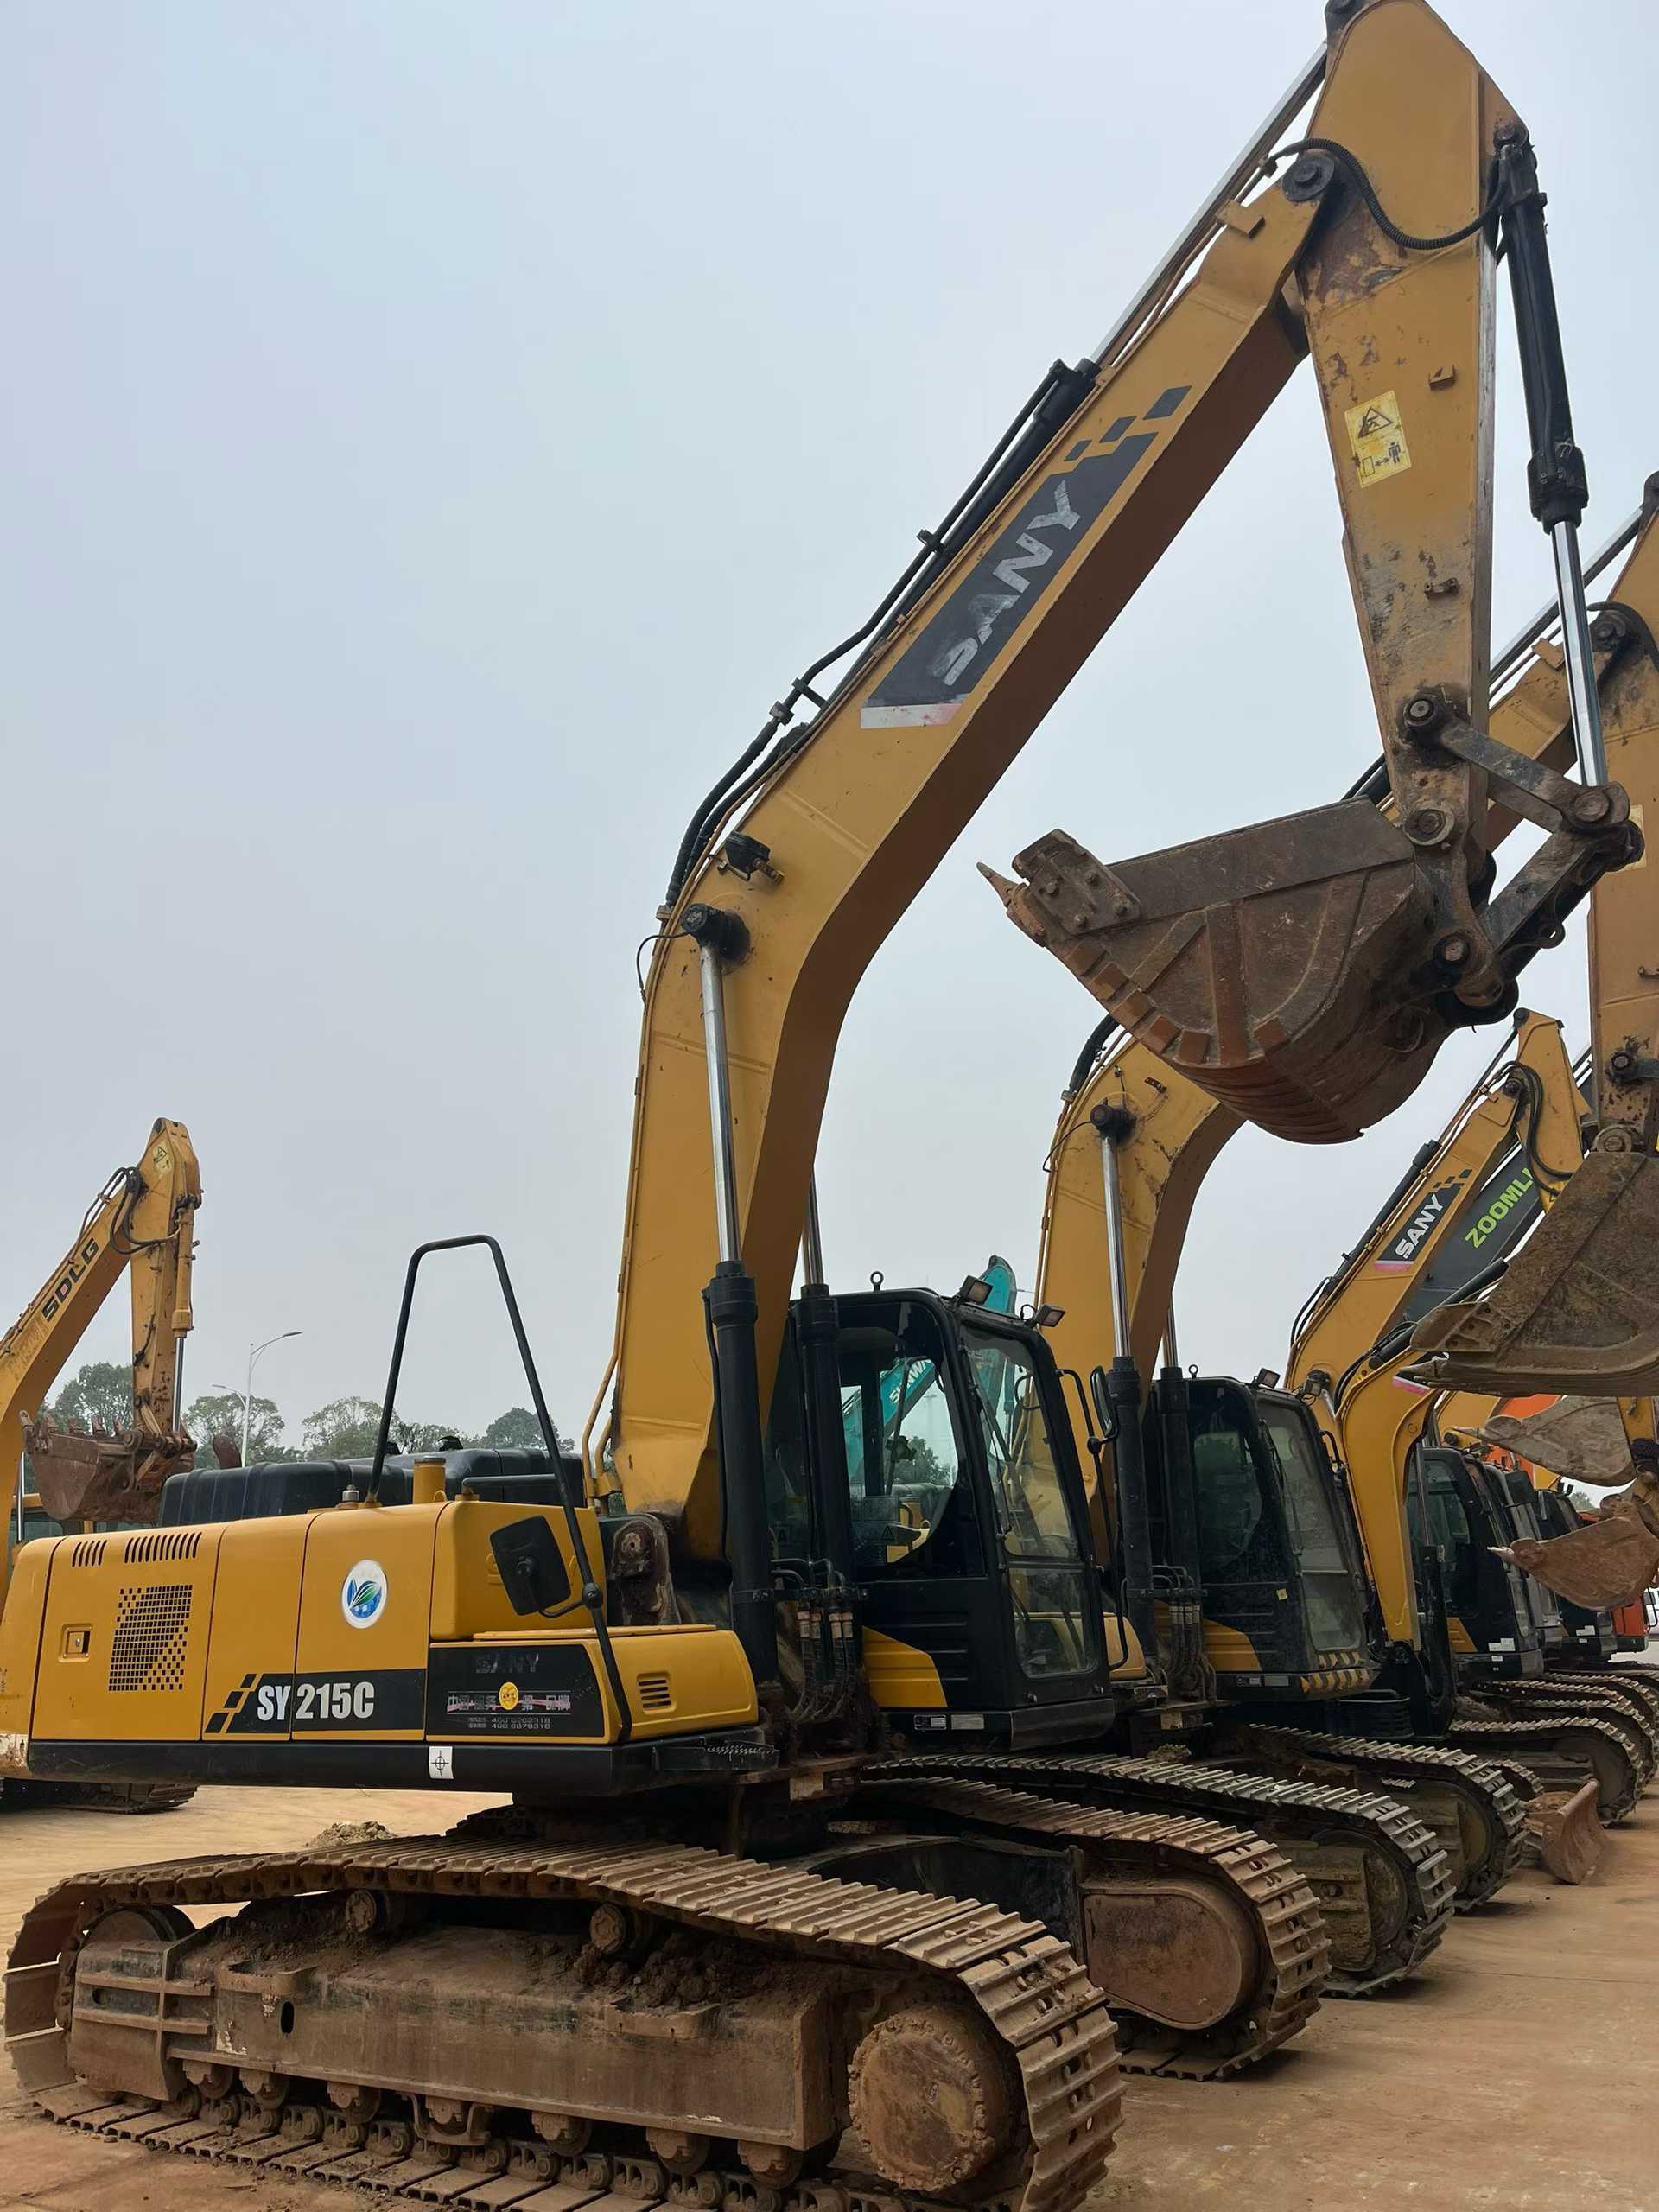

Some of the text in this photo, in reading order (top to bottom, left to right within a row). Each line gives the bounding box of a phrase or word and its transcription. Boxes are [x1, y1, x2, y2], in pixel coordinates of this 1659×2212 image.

[1395, 1194, 1443, 1259] SANY
[41, 1237, 99, 1322] SDLG
[257, 1681, 375, 1721] SY 215C
